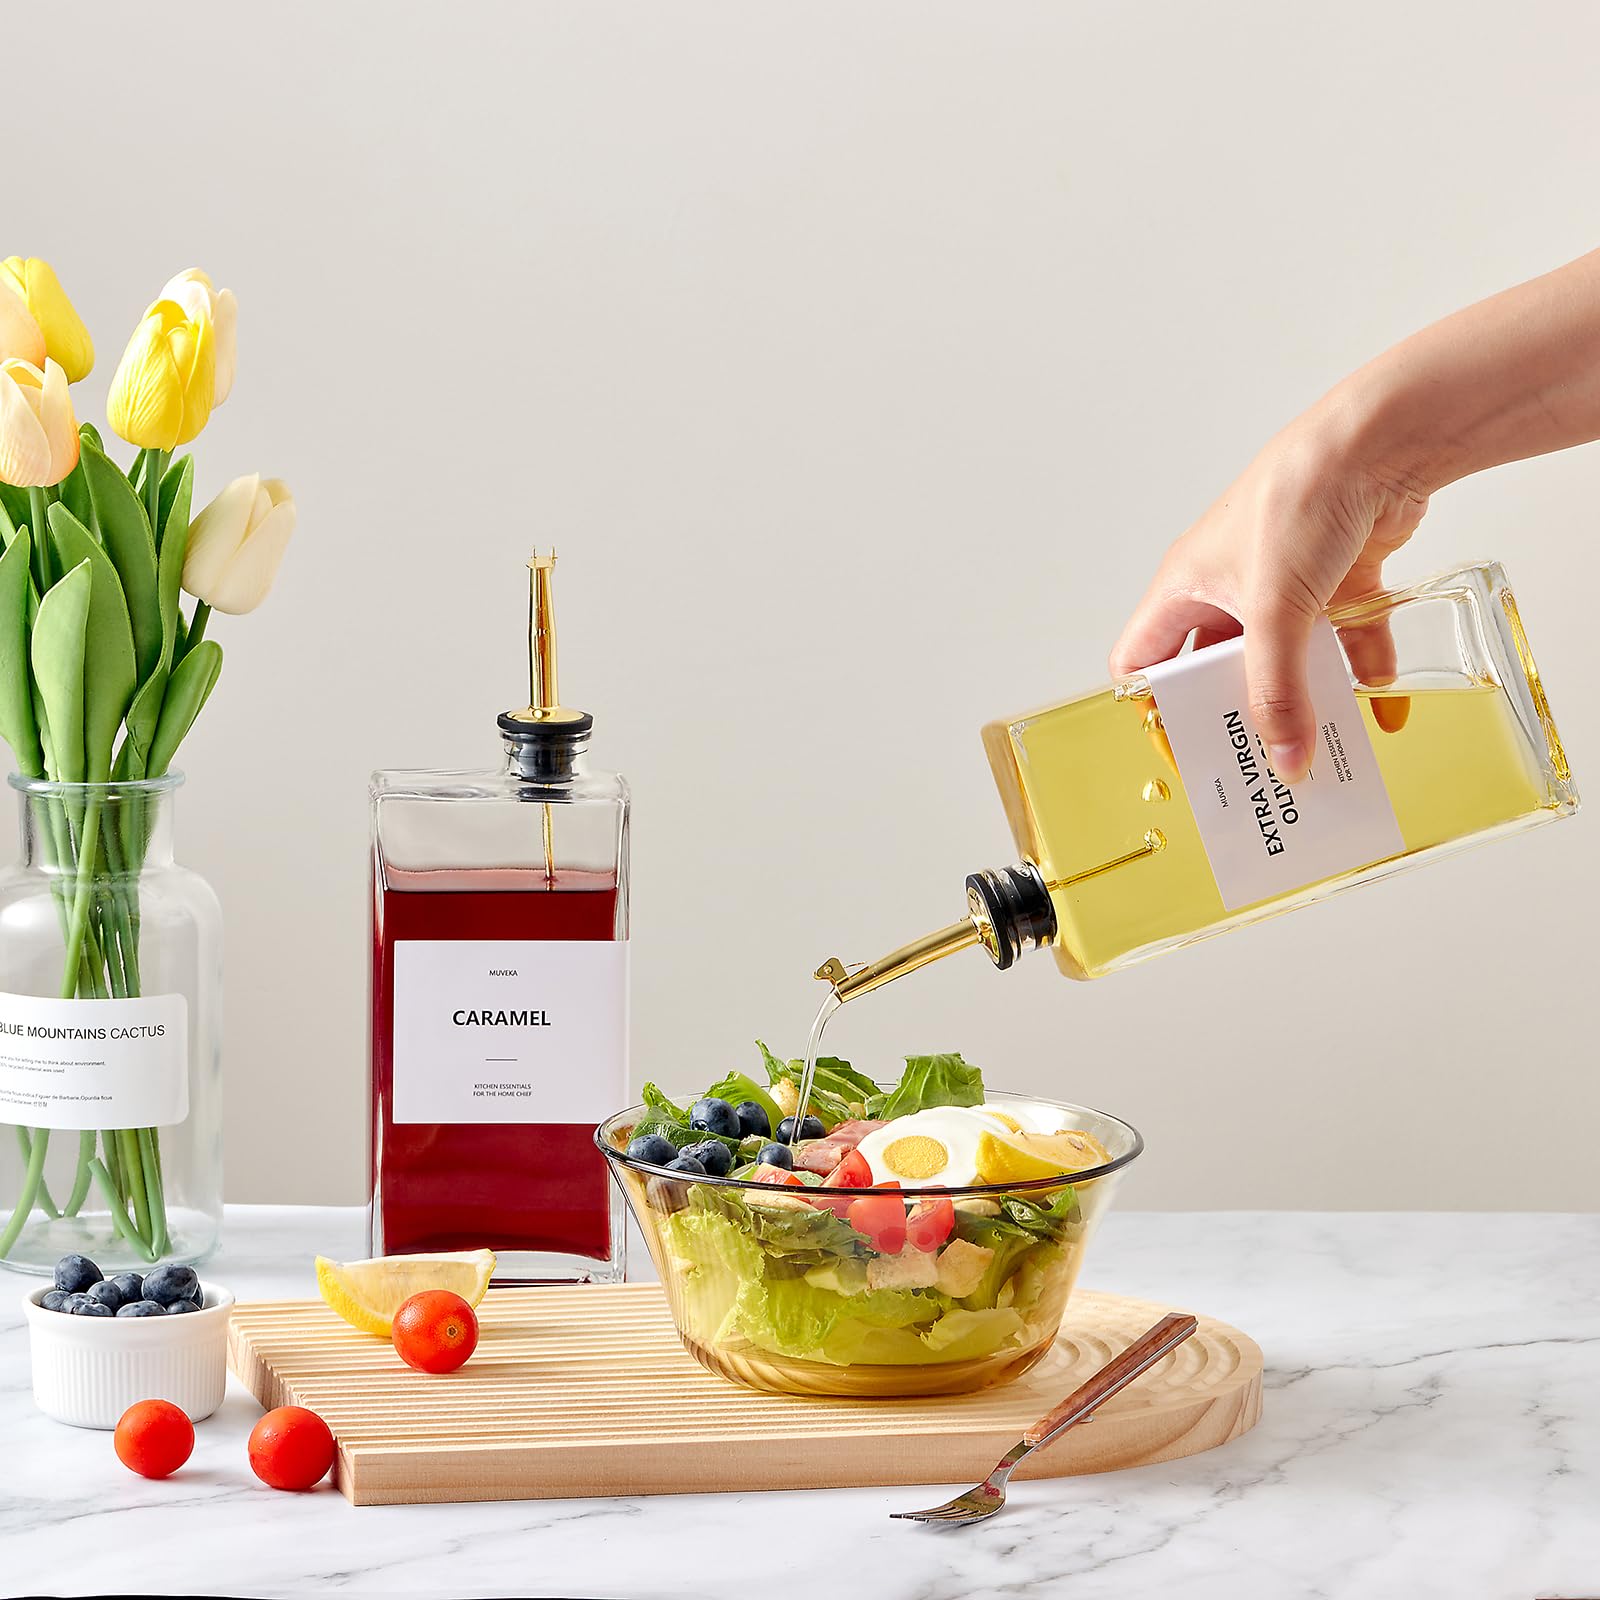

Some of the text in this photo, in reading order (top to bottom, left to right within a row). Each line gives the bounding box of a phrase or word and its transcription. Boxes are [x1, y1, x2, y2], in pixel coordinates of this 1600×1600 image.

[1322, 724, 1345, 783] KITCHEN ESSENTIALS
[1335, 738, 1345, 757] HOME
[1223, 711, 1285, 856] EXTRA VIRGIN
[1345, 768, 1353, 782] FOR
[1214, 778, 1229, 808] MUVEKA
[452, 1010, 551, 1026] CARAMEL
[27, 1026, 107, 1040] MOUNTAINS
[110, 1024, 165, 1040] CACTUS
